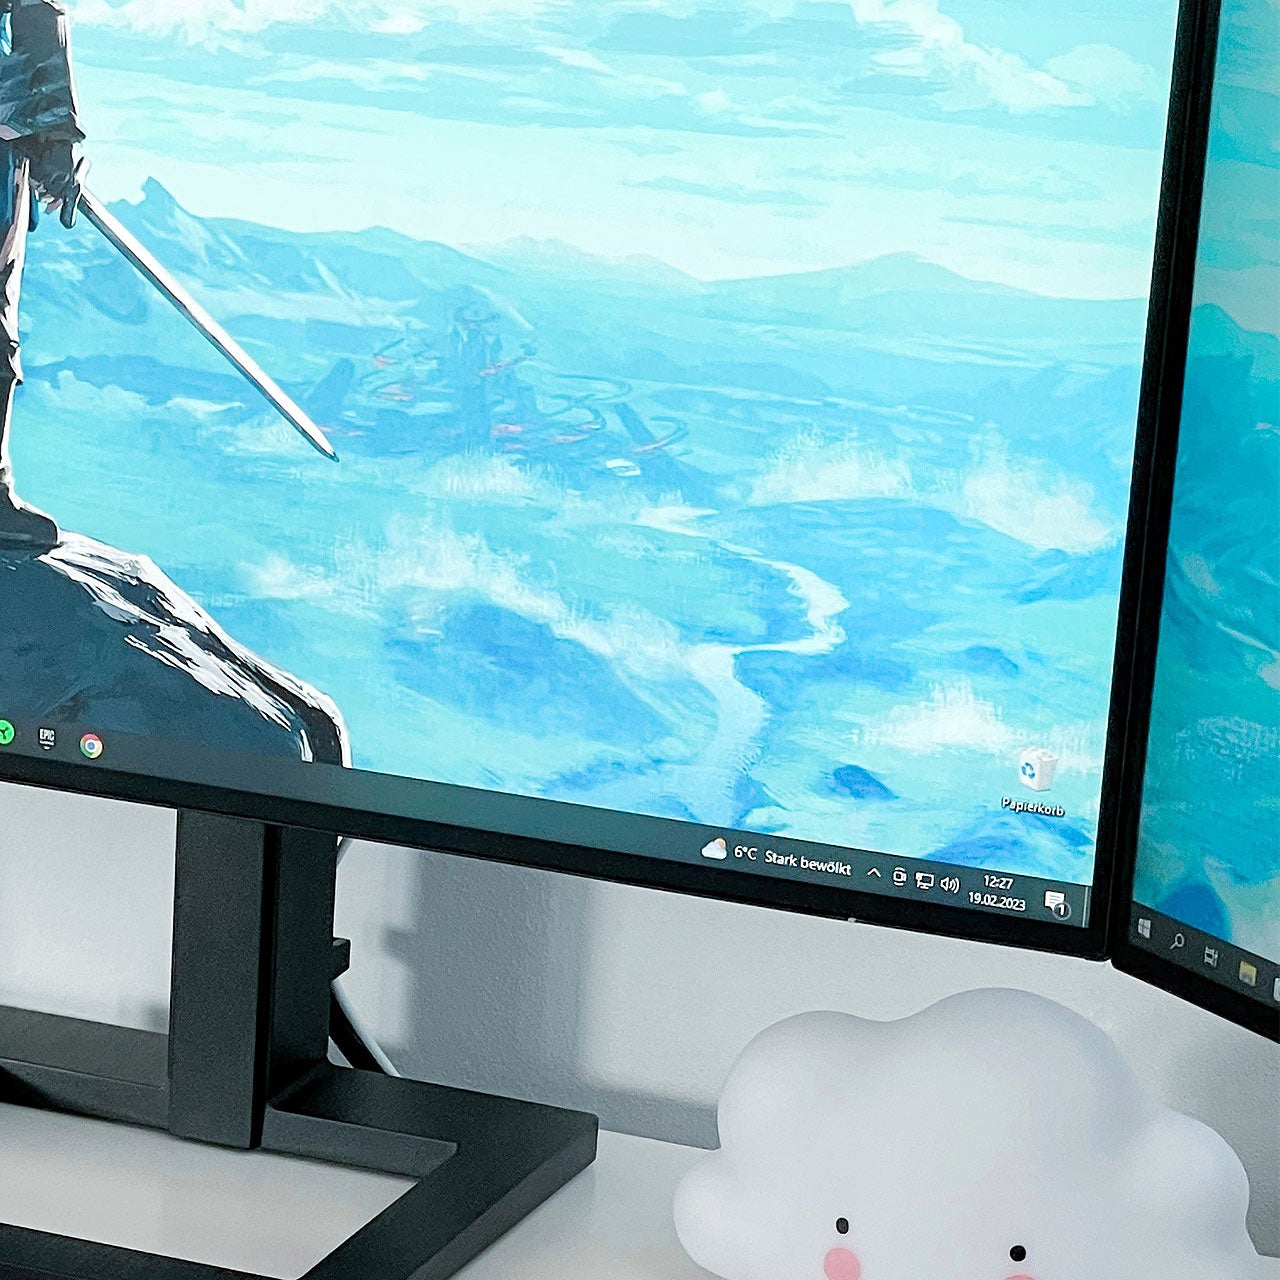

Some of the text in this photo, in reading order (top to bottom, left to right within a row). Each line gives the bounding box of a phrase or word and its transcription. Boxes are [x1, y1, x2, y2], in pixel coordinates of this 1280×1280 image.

[1001, 796, 1065, 817] Papierkorb
[734, 845, 852, 877] 6°C Stark bewölkt
[983, 874, 1014, 890] 12:27
[968, 891, 1026, 911] 19.02.2023
